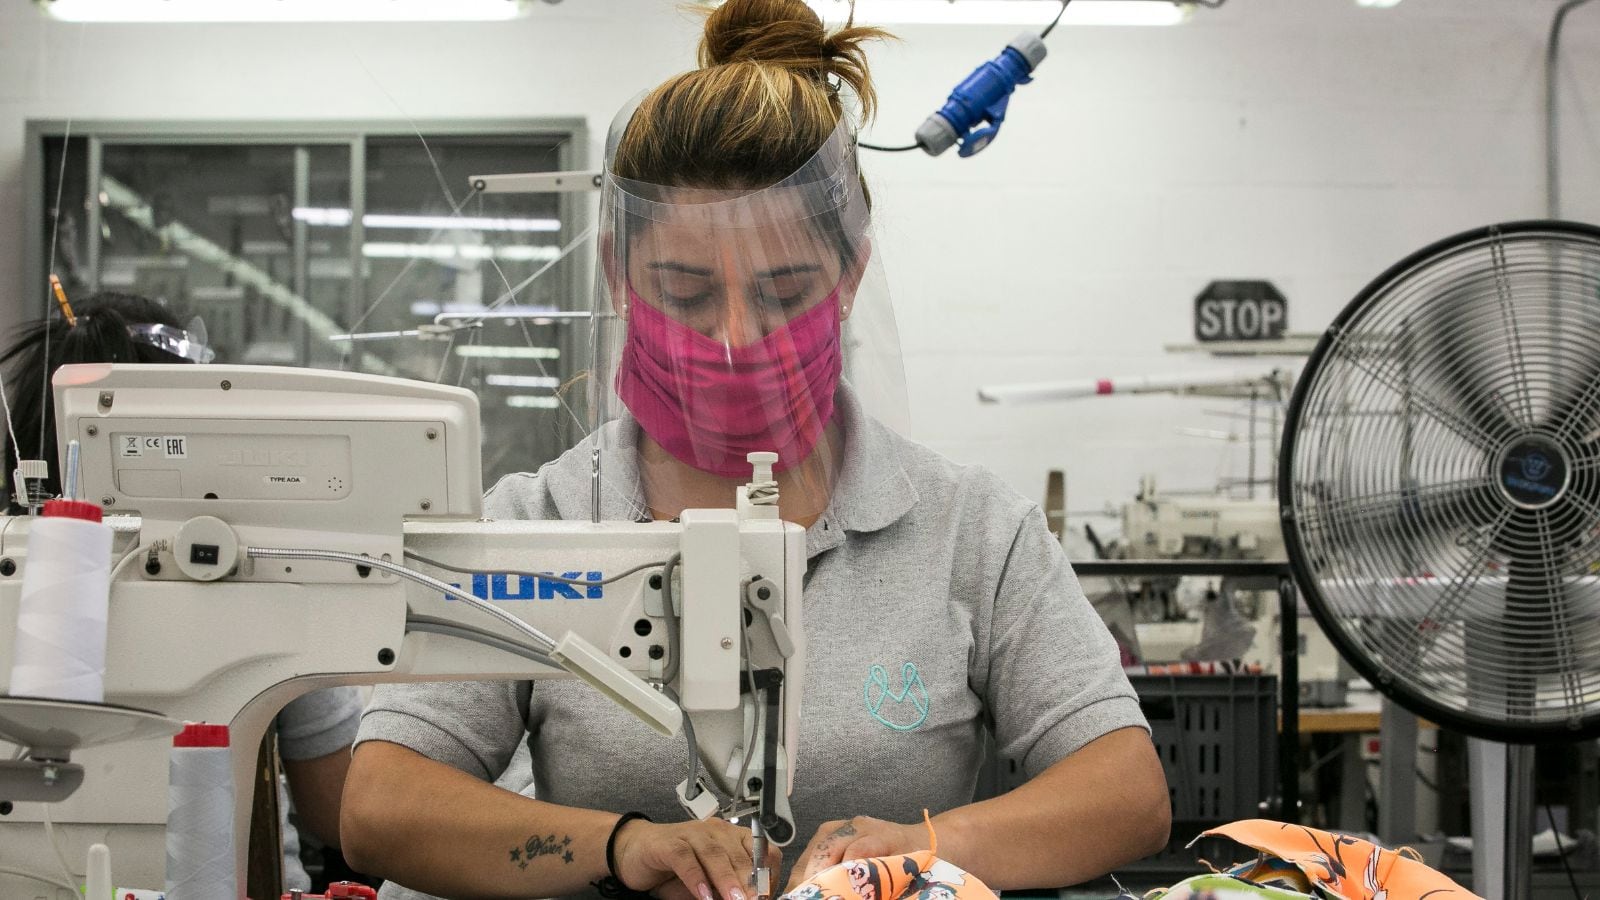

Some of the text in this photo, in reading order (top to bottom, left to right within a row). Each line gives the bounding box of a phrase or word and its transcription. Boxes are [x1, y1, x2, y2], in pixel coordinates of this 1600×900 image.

[1200, 300, 1282, 337] STOP
[146, 438, 160, 448] CE
[166, 438, 185, 456] EAC
